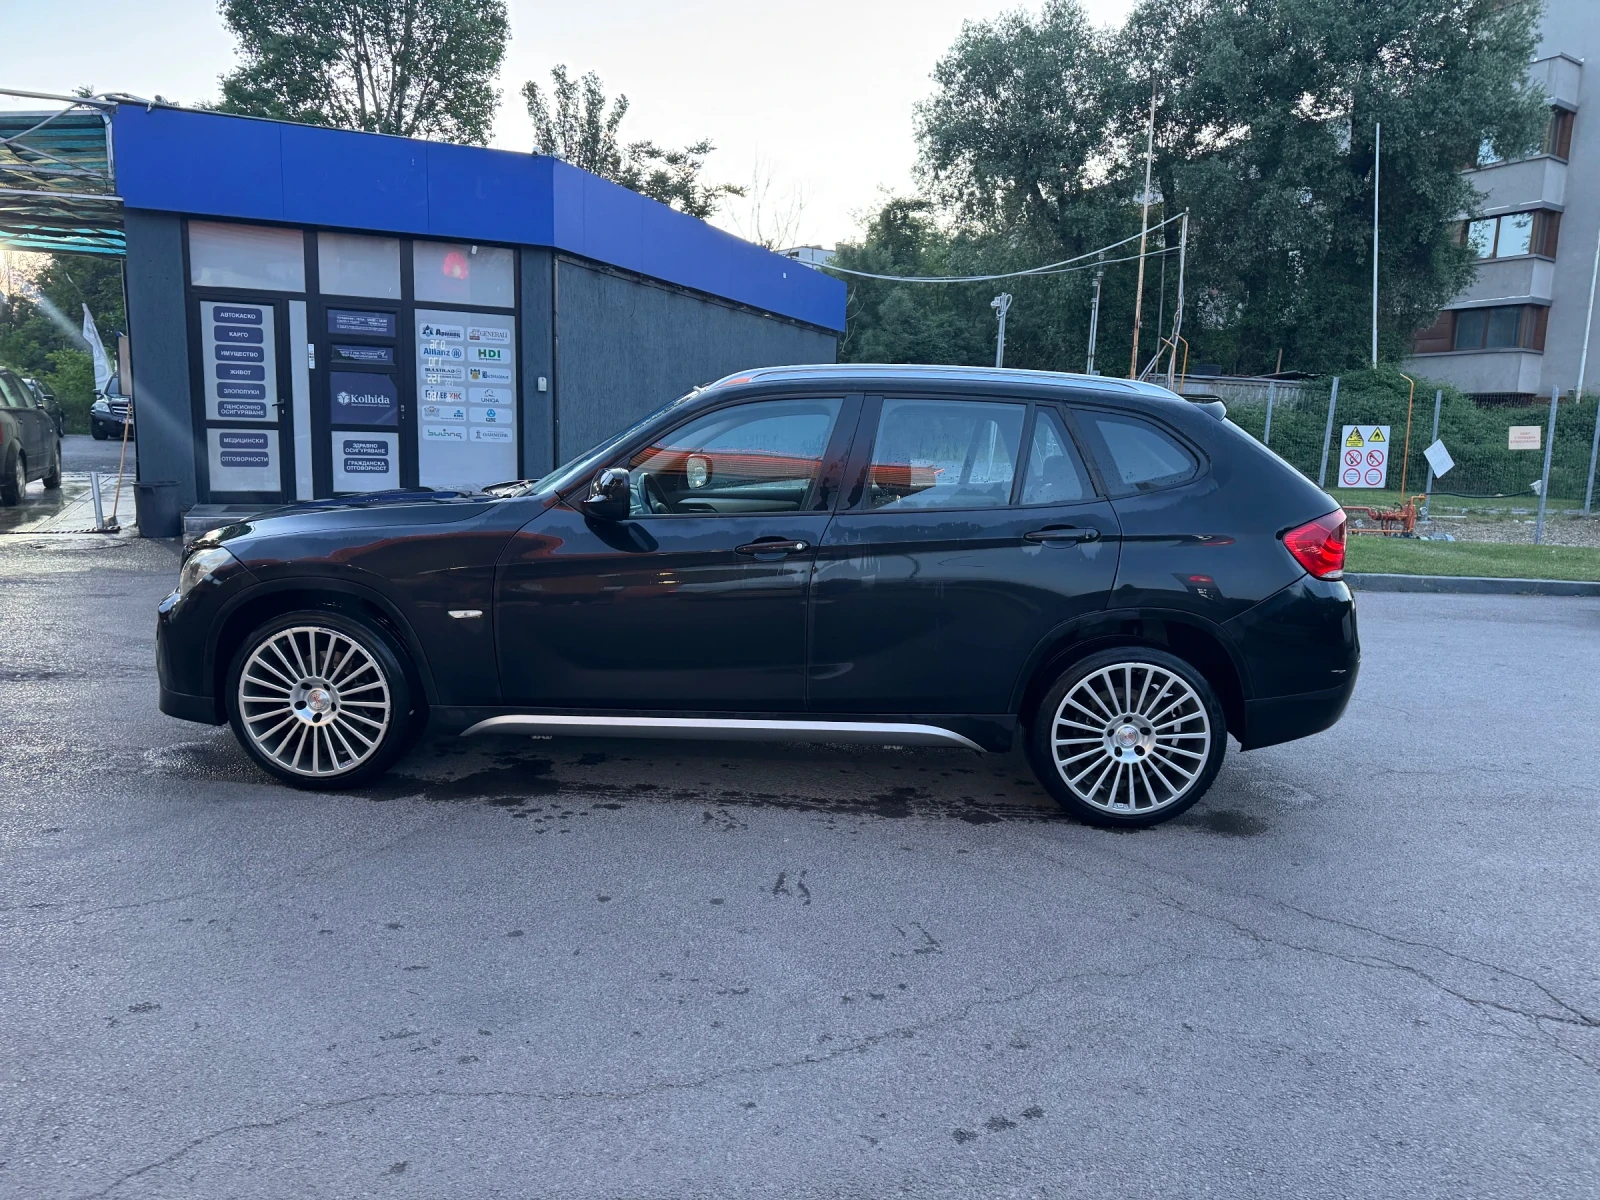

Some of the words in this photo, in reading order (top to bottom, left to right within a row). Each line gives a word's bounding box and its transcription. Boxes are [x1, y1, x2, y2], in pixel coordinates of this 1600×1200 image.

[480, 330, 508, 338] GENERALI
[424, 348, 450, 356] Allianz
[478, 348, 501, 358] HDI
[350, 394, 390, 404] Kolhida
